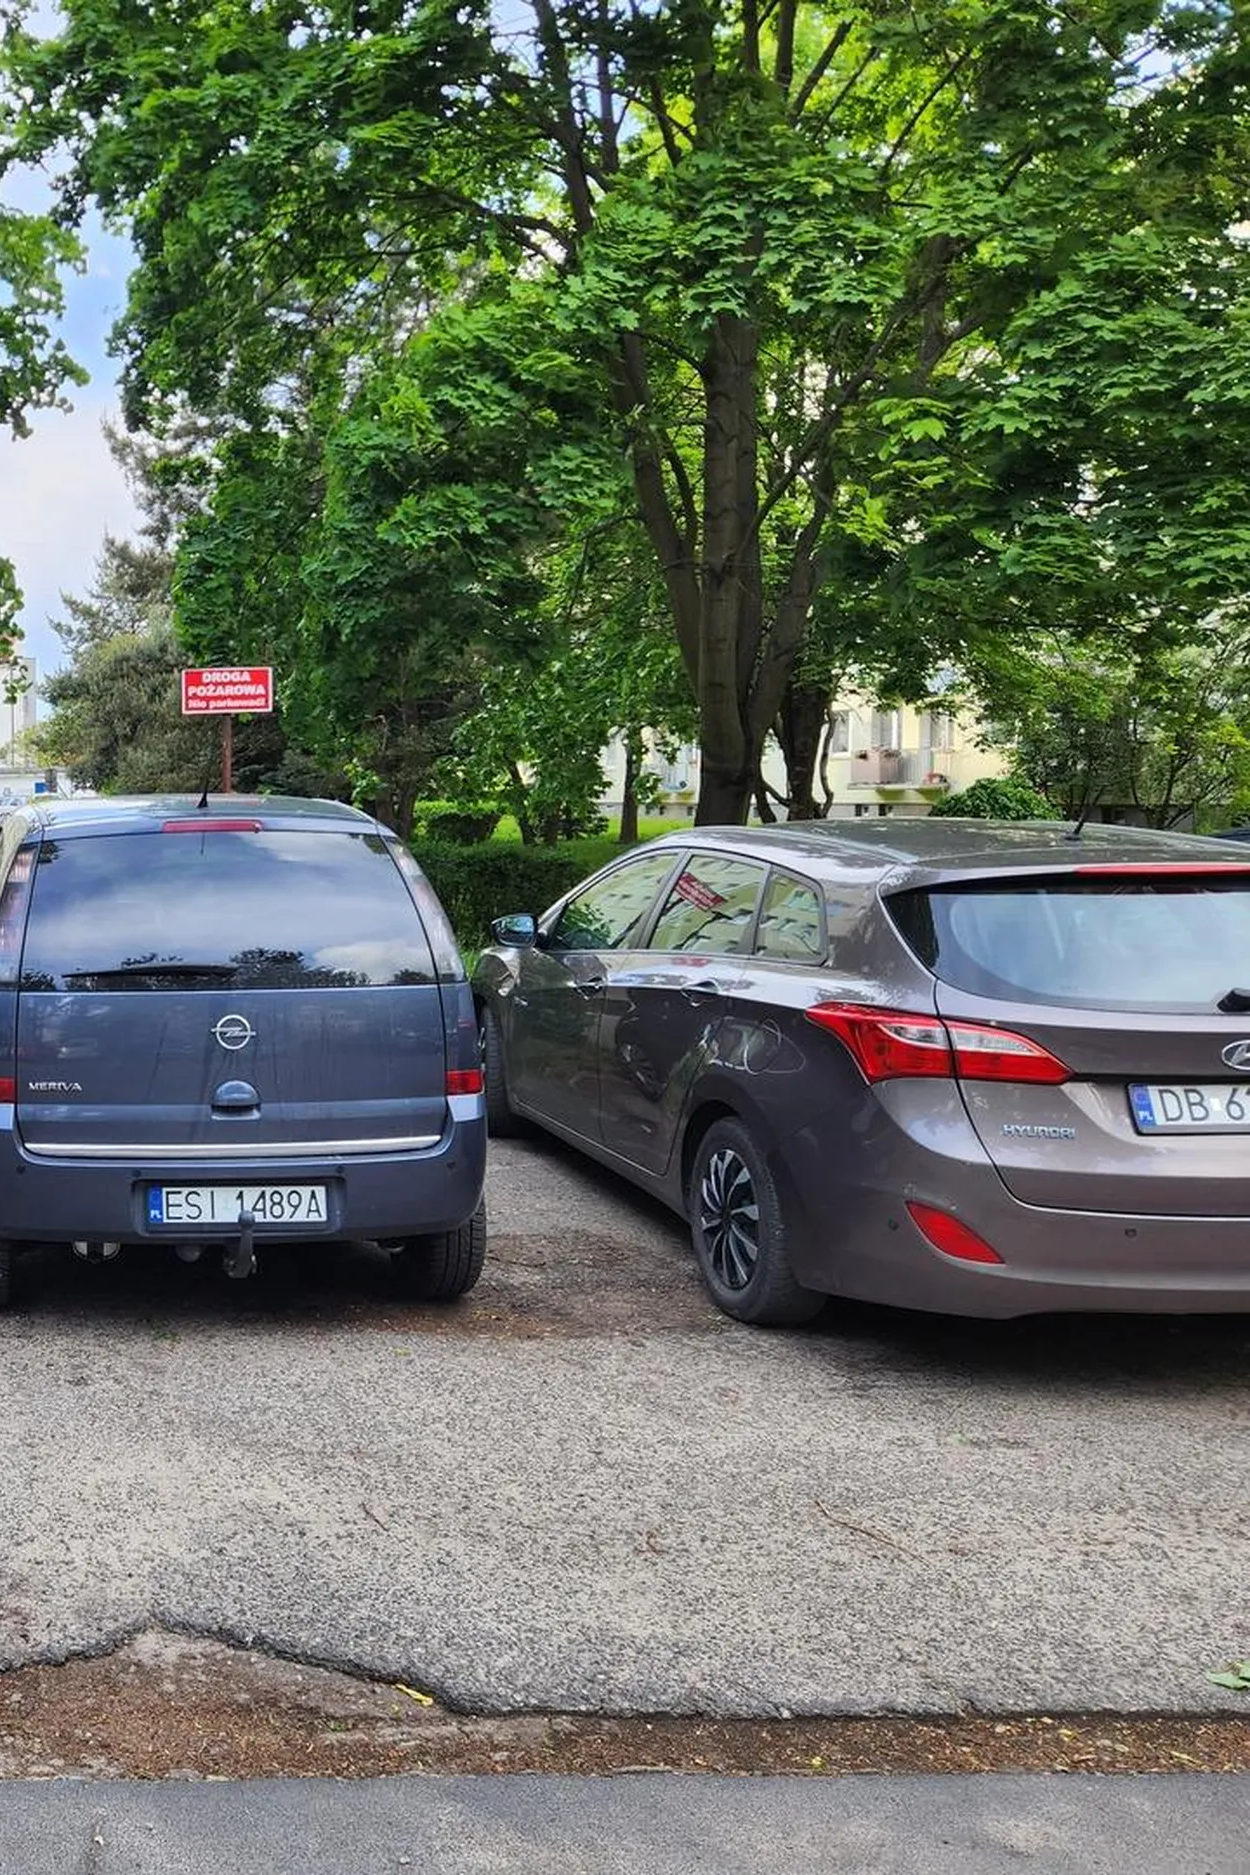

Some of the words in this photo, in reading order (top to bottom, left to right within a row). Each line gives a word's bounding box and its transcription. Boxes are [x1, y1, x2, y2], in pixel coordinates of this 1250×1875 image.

[202, 671, 251, 683] DROGA
[187, 684, 266, 697] POŻAROWA
[28, 1081, 83, 1092] MERIVA
[1157, 1088, 1210, 1122] DB
[1225, 1087, 1250, 1121] 6
[1002, 1124, 1076, 1140] HYUNDAI
[164, 1190, 215, 1220] ESI
[235, 1189, 323, 1220] 1489A
